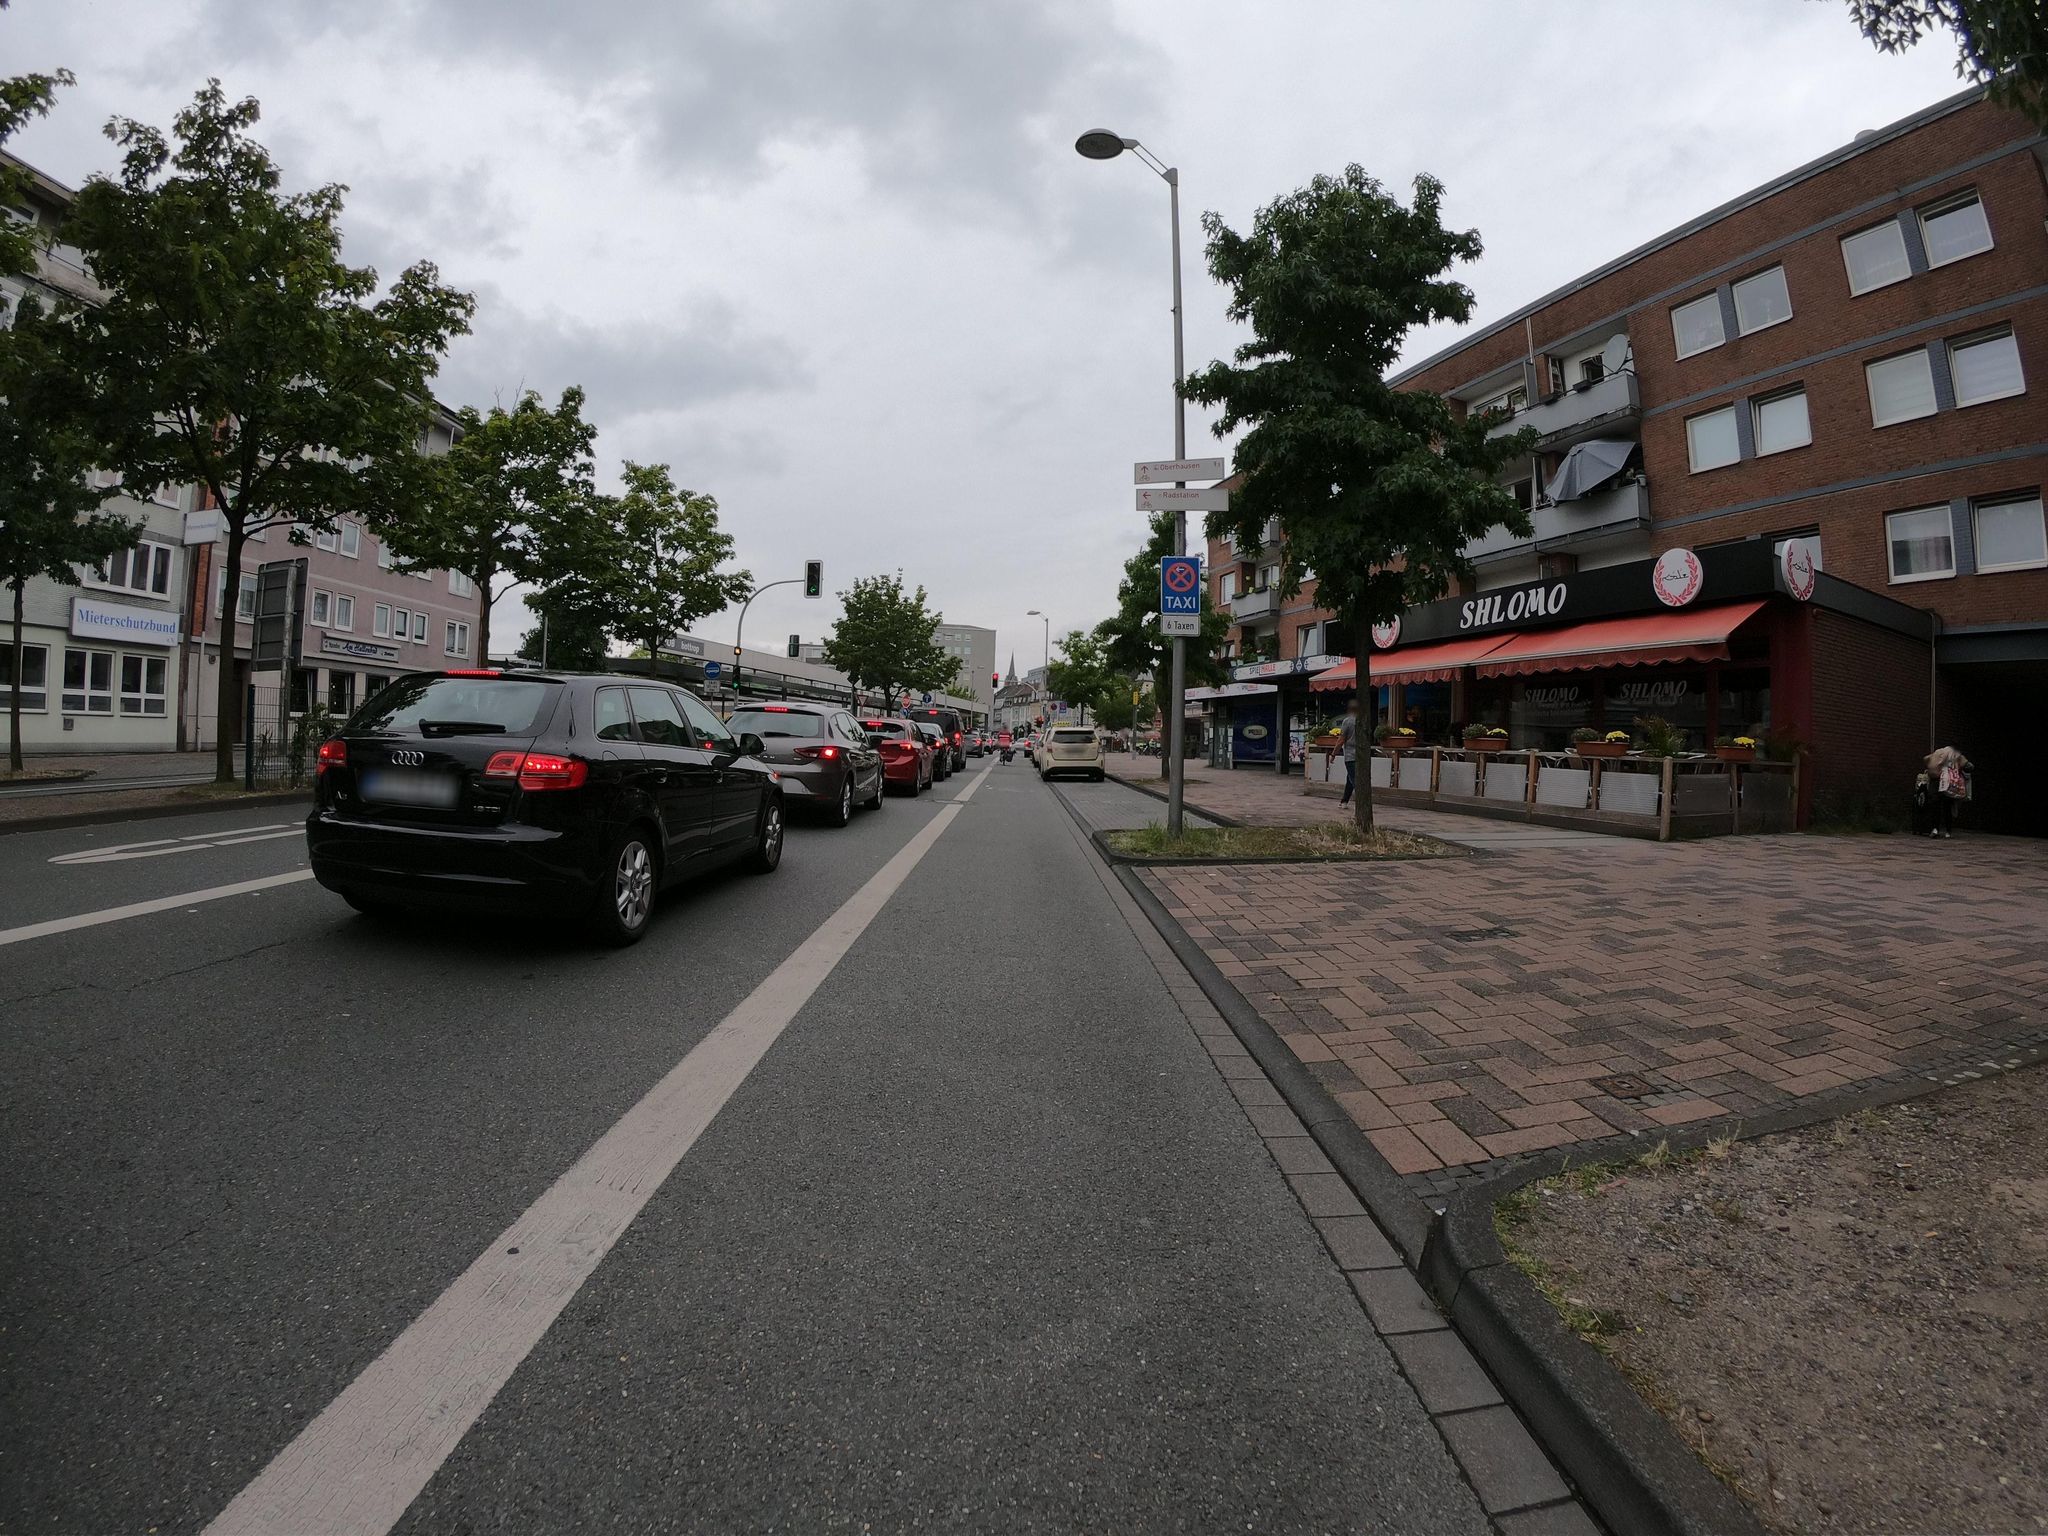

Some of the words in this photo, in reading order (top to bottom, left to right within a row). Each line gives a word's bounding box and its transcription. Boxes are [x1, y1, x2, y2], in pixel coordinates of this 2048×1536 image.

[1160, 463, 1200, 471] Oberhausen
[1162, 491, 1199, 499] Radstation
[1165, 596, 1196, 609] TAXI
[1460, 583, 1567, 629] SHLOMO
[78, 608, 176, 634] Mieterschutzbund
[1167, 621, 1172, 630] 6
[1173, 620, 1195, 631] Taxen
[1524, 686, 1579, 703] SHLOMO
[1620, 680, 1688, 700] SHLOMO
